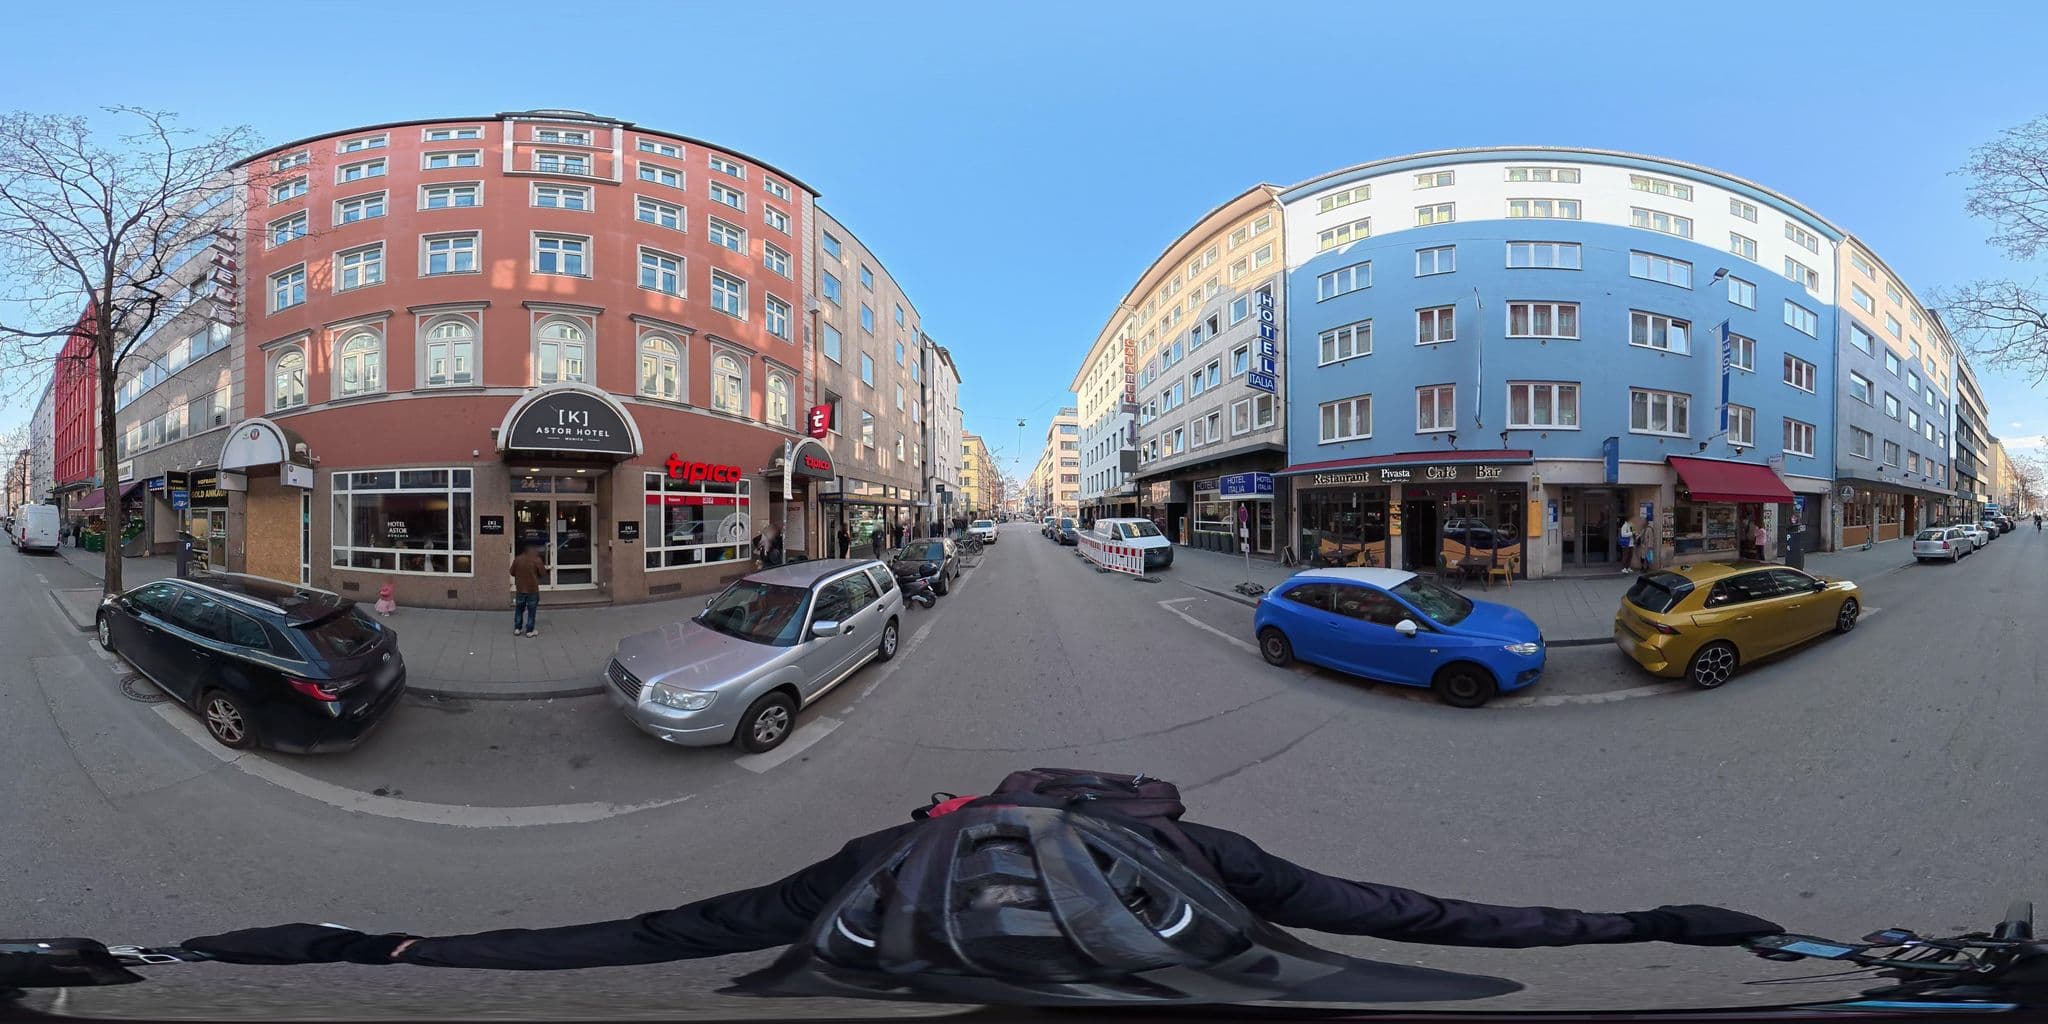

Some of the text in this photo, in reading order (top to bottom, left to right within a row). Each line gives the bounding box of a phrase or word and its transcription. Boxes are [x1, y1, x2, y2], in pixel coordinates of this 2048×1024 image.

[1262, 294, 1273, 373] HOTEL
[1722, 337, 1730, 375] HOTEL
[1249, 373, 1274, 389] ITALIA
[577, 429, 609, 437] HOTEL
[665, 453, 741, 485] tipico
[804, 455, 830, 470] tipico
[1227, 475, 1246, 484] HOTEL
[1313, 471, 1369, 485] Restaurant
[1381, 468, 1410, 478] Pivasta
[1426, 465, 1502, 480] Café Bar
[1227, 485, 1245, 493] ITALIA
